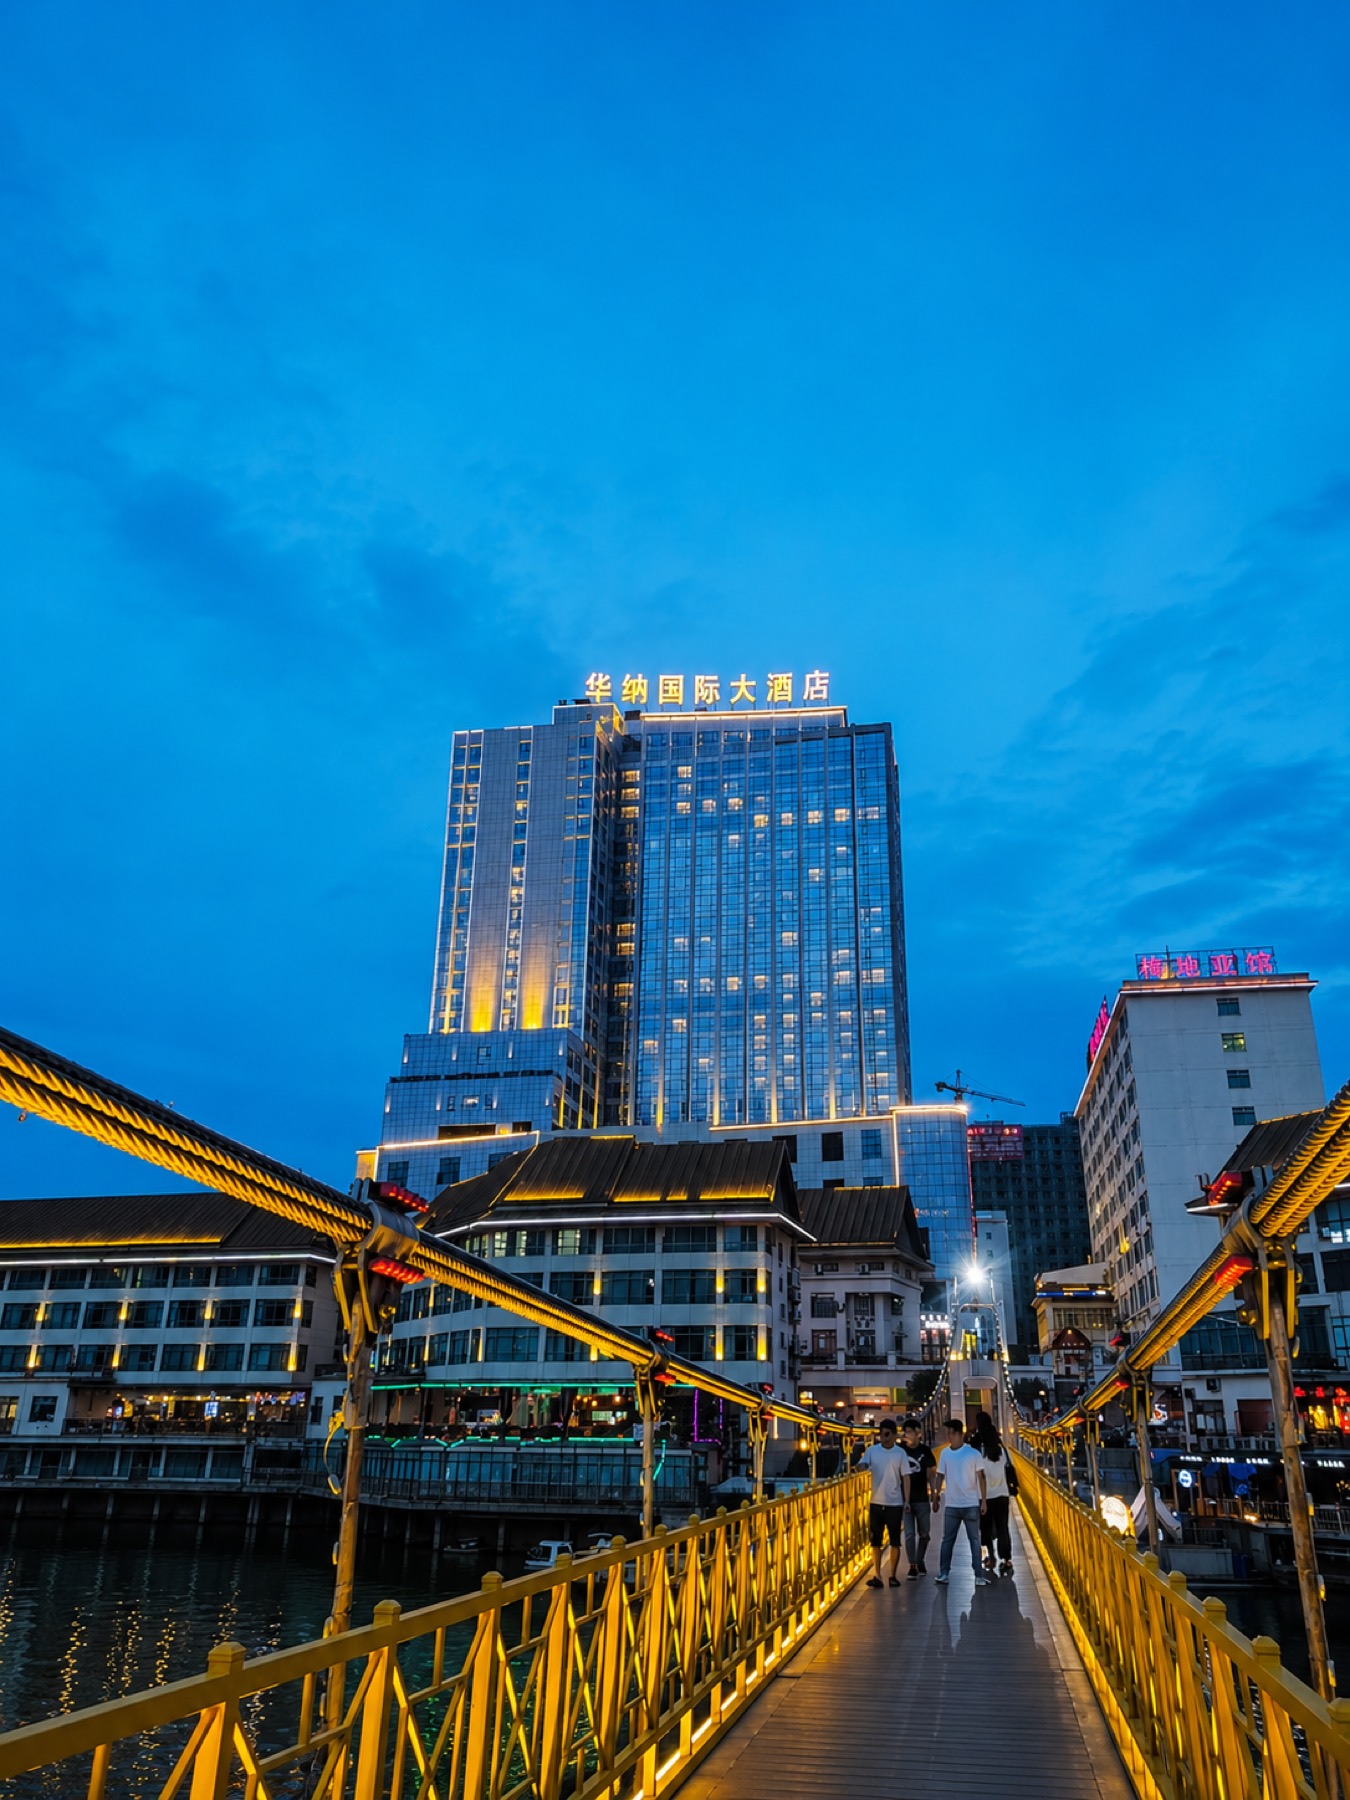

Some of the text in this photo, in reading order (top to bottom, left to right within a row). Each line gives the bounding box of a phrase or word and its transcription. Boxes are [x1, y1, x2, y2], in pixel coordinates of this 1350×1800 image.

[585, 670, 829, 705] 华纳国际大酒店
